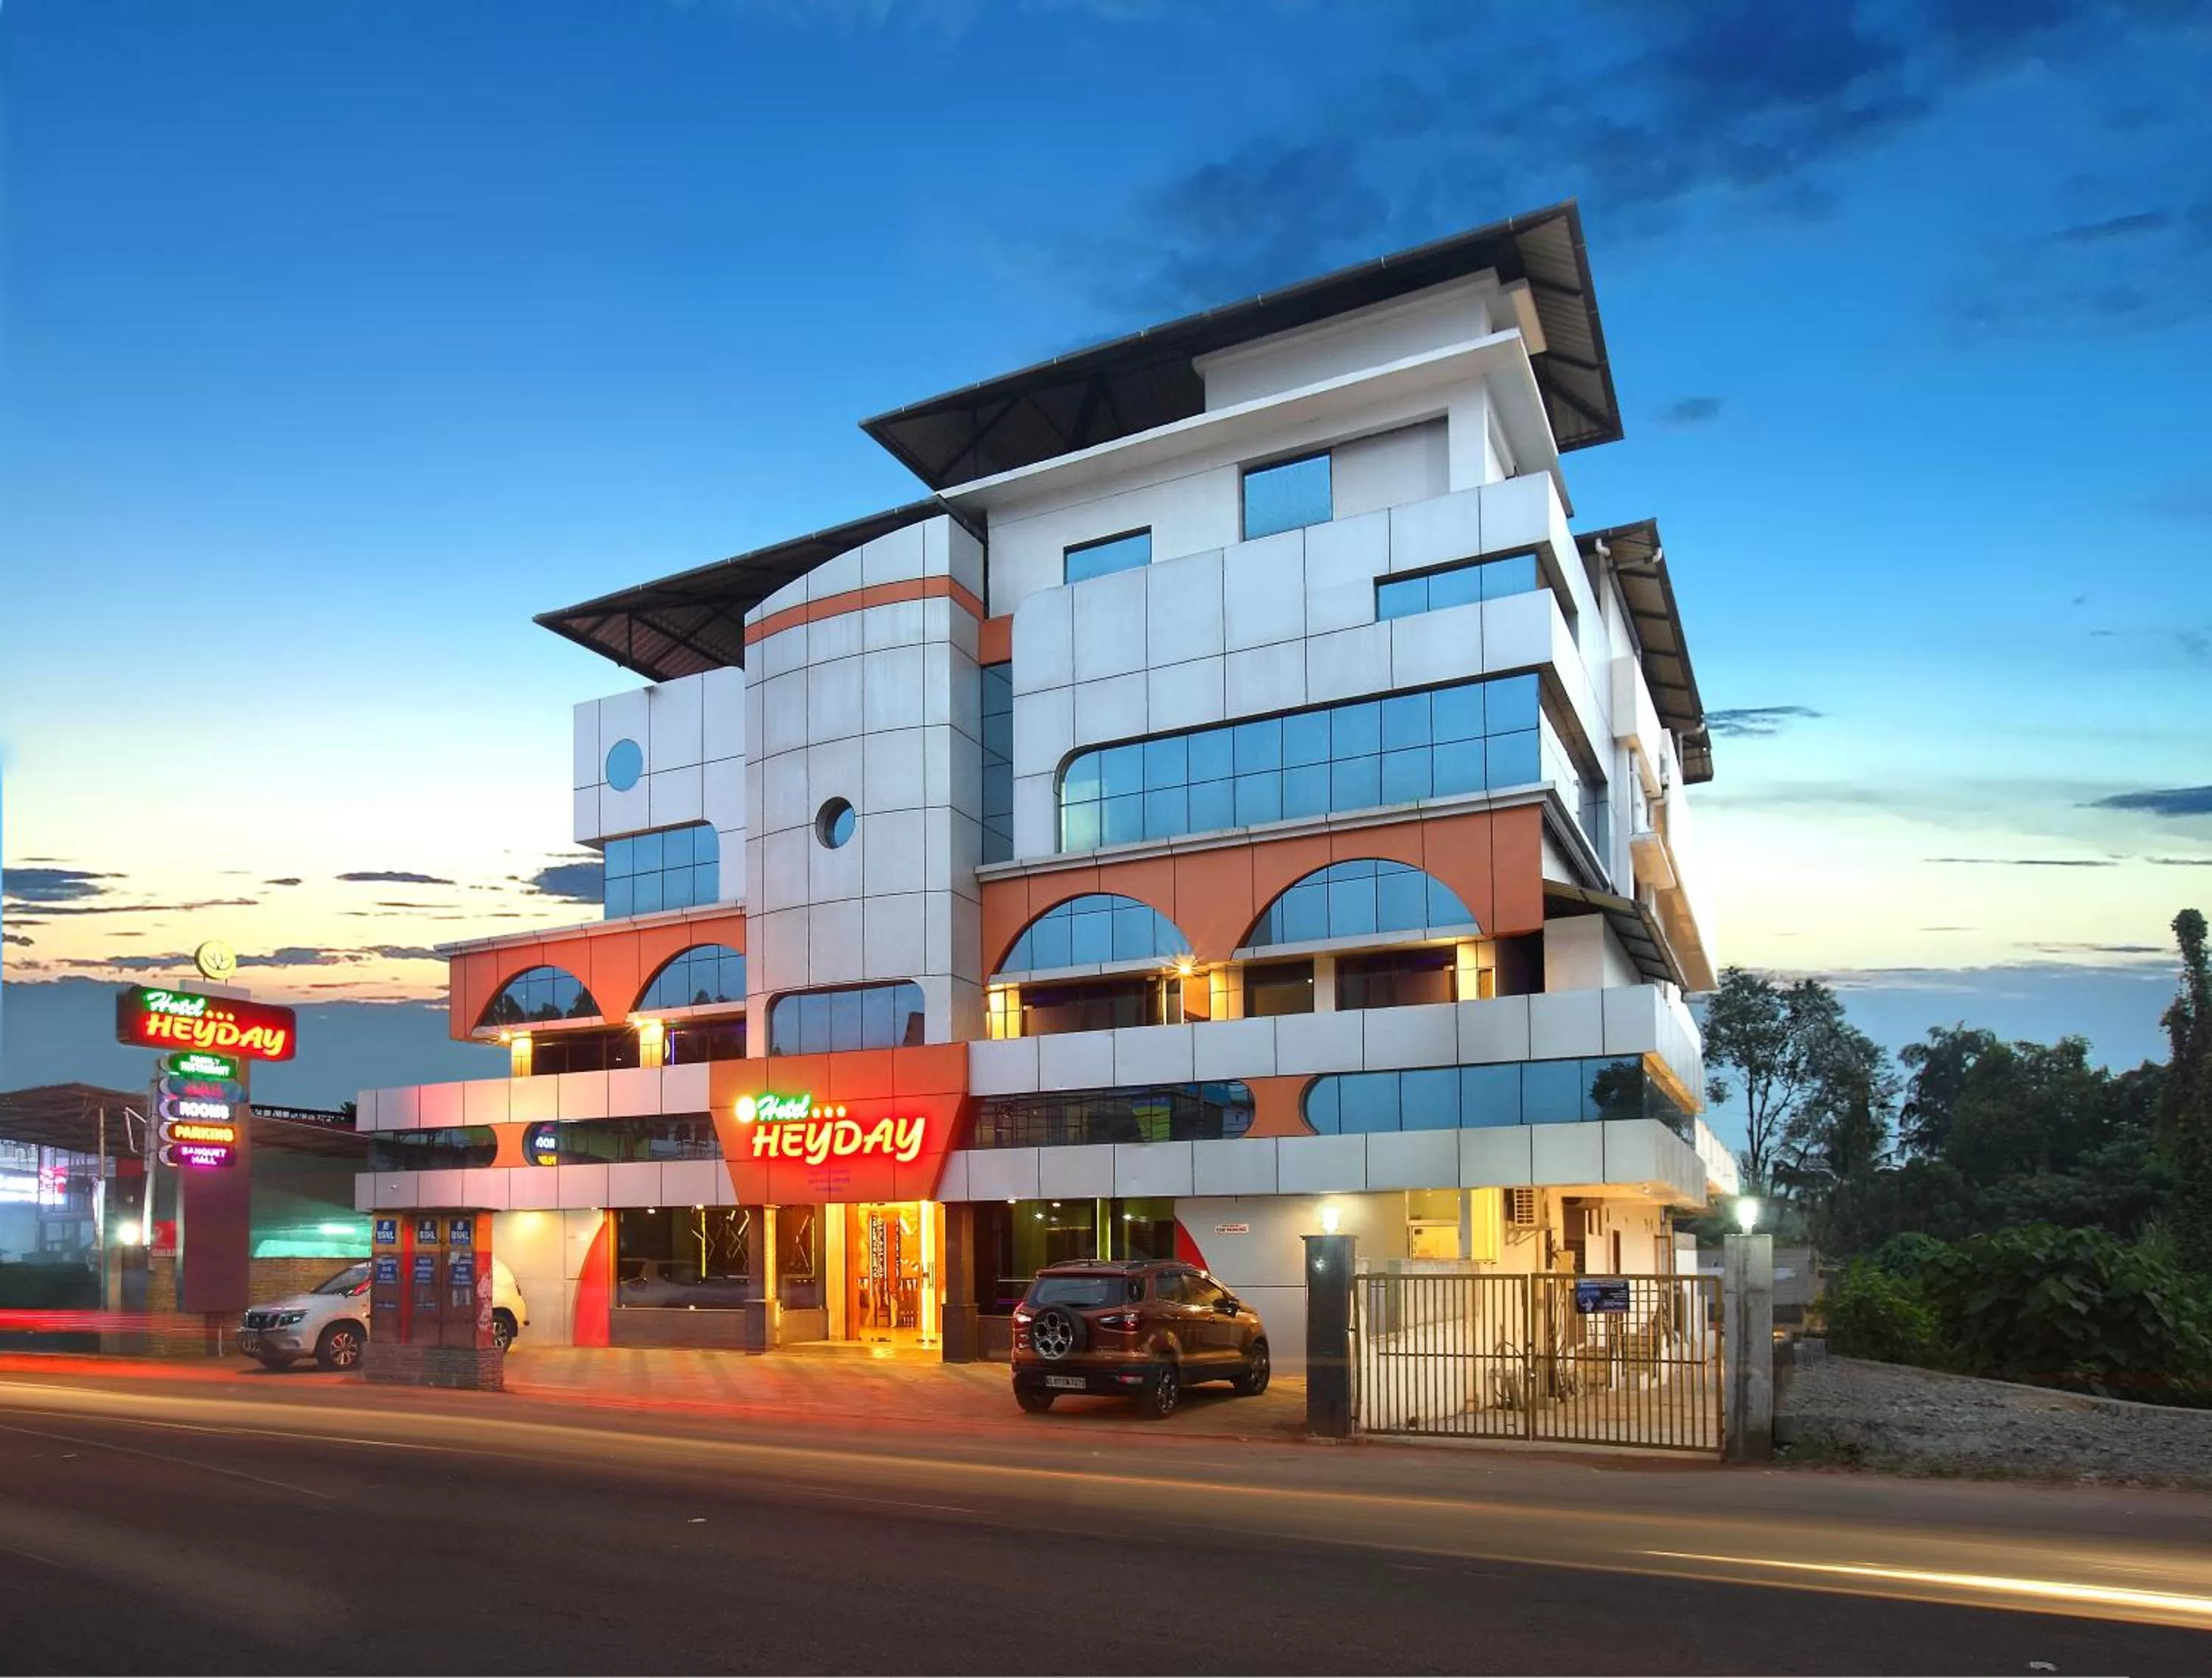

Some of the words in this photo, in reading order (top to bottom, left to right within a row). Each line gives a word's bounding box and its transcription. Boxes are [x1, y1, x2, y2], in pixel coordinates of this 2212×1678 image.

[145, 992, 206, 1017] Hotel
[146, 1013, 286, 1056] HEYDAY
[179, 1101, 230, 1120] ROOMS
[755, 1094, 811, 1121] Hotel
[175, 1124, 234, 1142] PARKING
[751, 1117, 926, 1165] HEYDAY
[377, 1230, 394, 1239] BSNL
[419, 1230, 436, 1239] BSNL
[451, 1230, 470, 1239] BSNL
